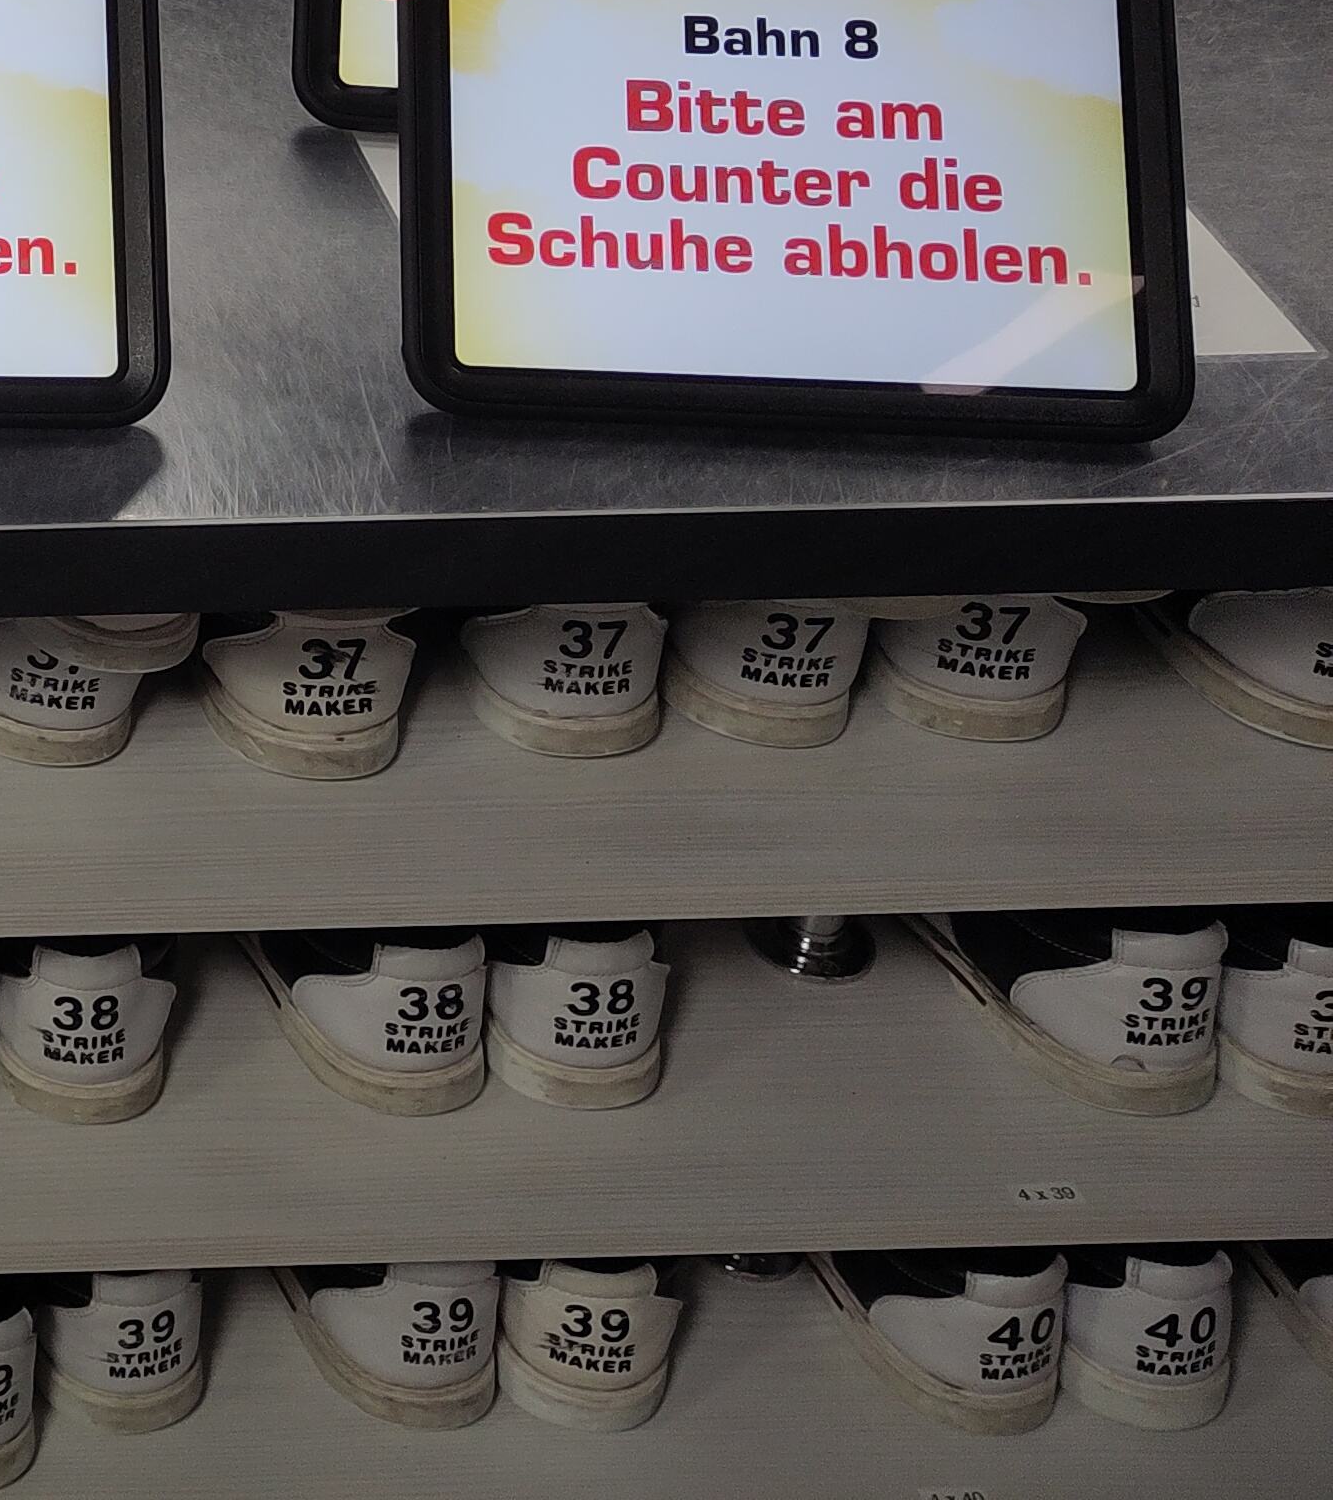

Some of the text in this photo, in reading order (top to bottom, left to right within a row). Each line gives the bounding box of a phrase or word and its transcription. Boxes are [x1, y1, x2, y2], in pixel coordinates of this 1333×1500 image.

[684, 14, 879, 59] Bahn 8
[626, 78, 943, 141] Bitte am
[572, 146, 1004, 213] Counter die
[486, 212, 1093, 287] Schuhe abholen.
[762, 612, 834, 653] 37
[955, 602, 1031, 645] 37
[559, 620, 628, 659] 37
[938, 639, 1036, 663] STRIKE
[298, 638, 367, 681] 37
[543, 658, 634, 678] STRIKE
[741, 648, 835, 670] STRIKE
[936, 655, 1031, 680] MAKER
[11, 668, 100, 693] STRIKE
[282, 678, 378, 697] STRIKE
[544, 676, 631, 696] MAKER
[740, 664, 830, 687] MAKER
[284, 698, 373, 716] MAKER
[397, 983, 465, 1021] 38
[567, 980, 635, 1016] 38
[1139, 976, 1212, 1011] 39
[53, 995, 119, 1031] 38
[554, 1013, 640, 1035] STRIKE
[1125, 1008, 1211, 1031] STRIKE
[42, 1028, 126, 1049] STRIKE
[385, 1017, 472, 1039] STRIKE
[555, 1029, 637, 1049] MAKER
[1126, 1025, 1207, 1046] MAKER
[43, 1045, 124, 1063] MAKER
[386, 1035, 466, 1054] MAKER
[1019, 1189, 1030, 1201] 4
[1052, 1187, 1076, 1201] 39
[412, 1297, 474, 1334] 39
[560, 1304, 630, 1343] 39
[1145, 1306, 1217, 1348] 40
[118, 1310, 176, 1349] 39
[401, 1329, 479, 1352] STRIKE
[988, 1308, 1056, 1351] 40
[106, 1337, 183, 1364] STRIKE
[403, 1345, 477, 1366] MAKER
[545, 1332, 636, 1358] STRIKE
[979, 1344, 1052, 1366] STRIKE
[1136, 1341, 1217, 1363] STRIKE
[109, 1354, 181, 1379] MAKER
[549, 1347, 631, 1374] MAKER
[981, 1355, 1050, 1380] MAKER
[1137, 1355, 1214, 1376] MAKER
